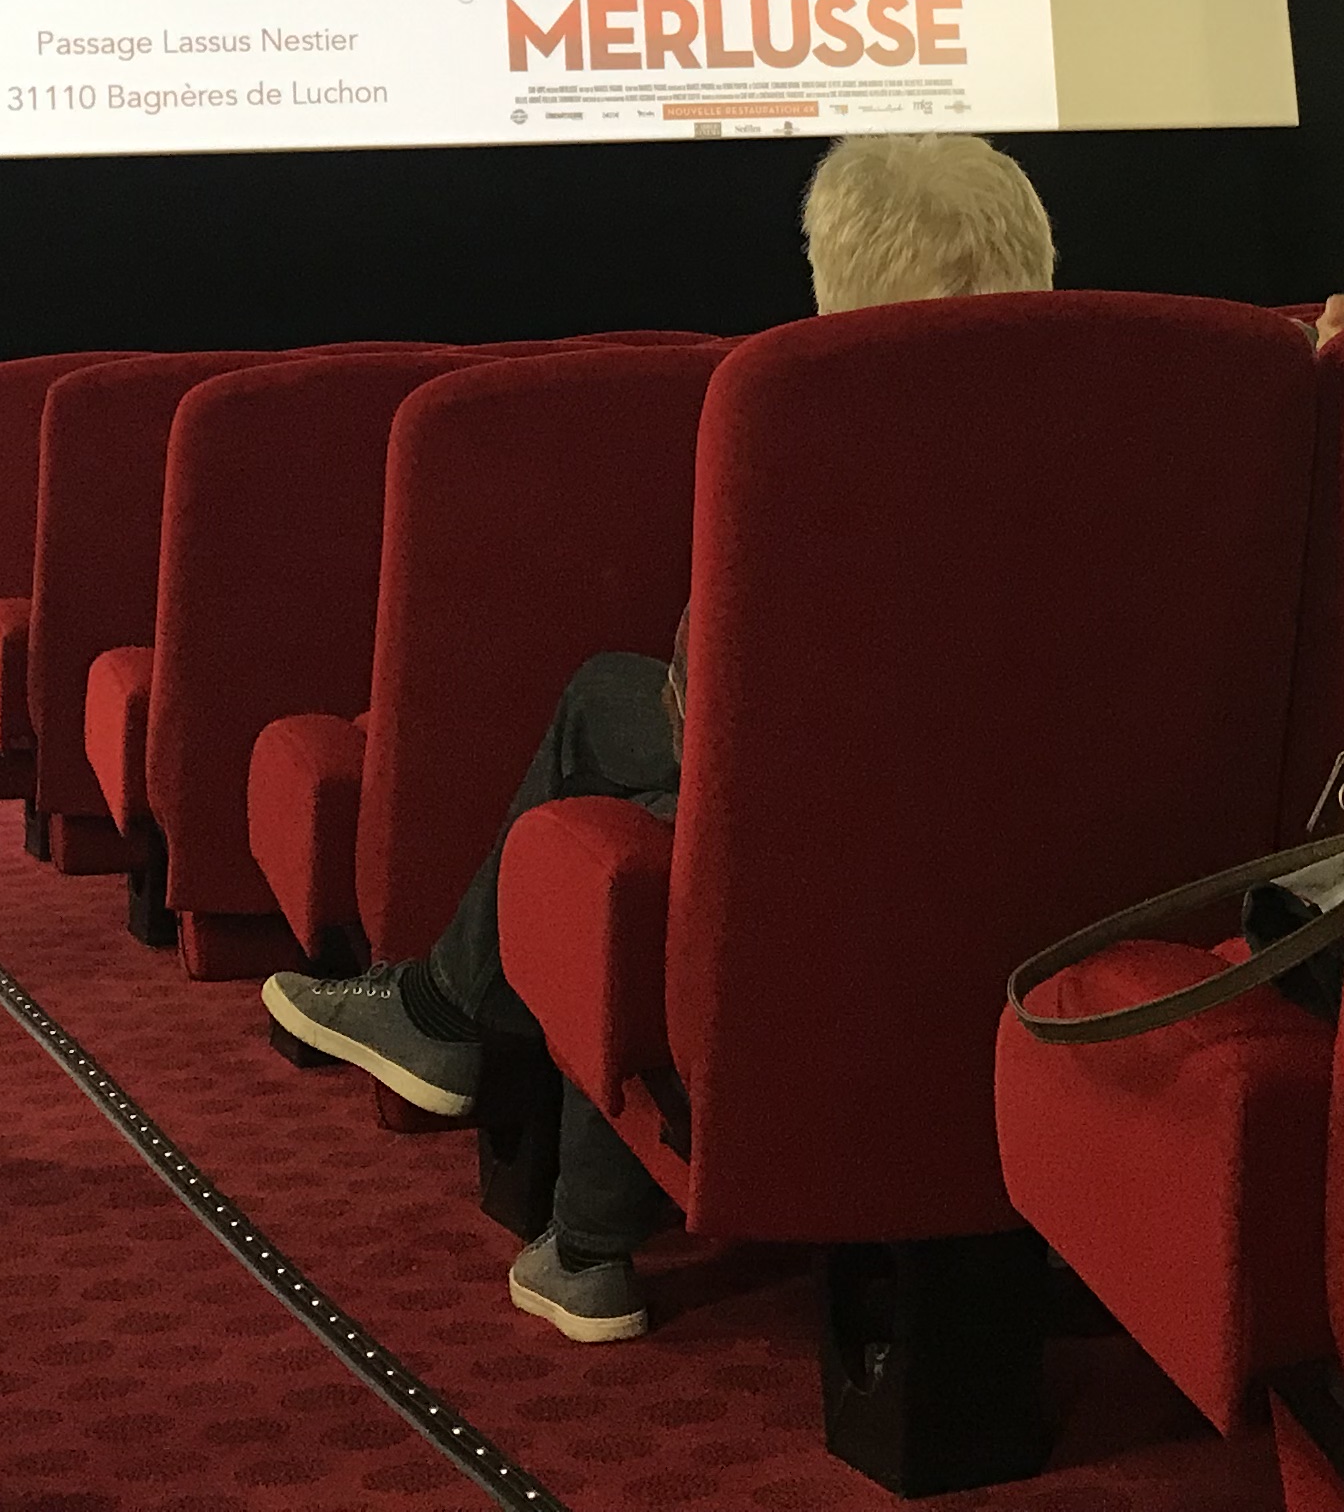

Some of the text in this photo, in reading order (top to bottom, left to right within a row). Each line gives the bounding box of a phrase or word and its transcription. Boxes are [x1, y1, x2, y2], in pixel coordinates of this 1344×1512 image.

[37, 27, 358, 62] Passage Lassus Nestier
[7, 78, 388, 116] 31110 Bagnères de Luchon
[667, 106, 722, 117] NOUVELLE
[725, 105, 801, 116] RESTAURATION
